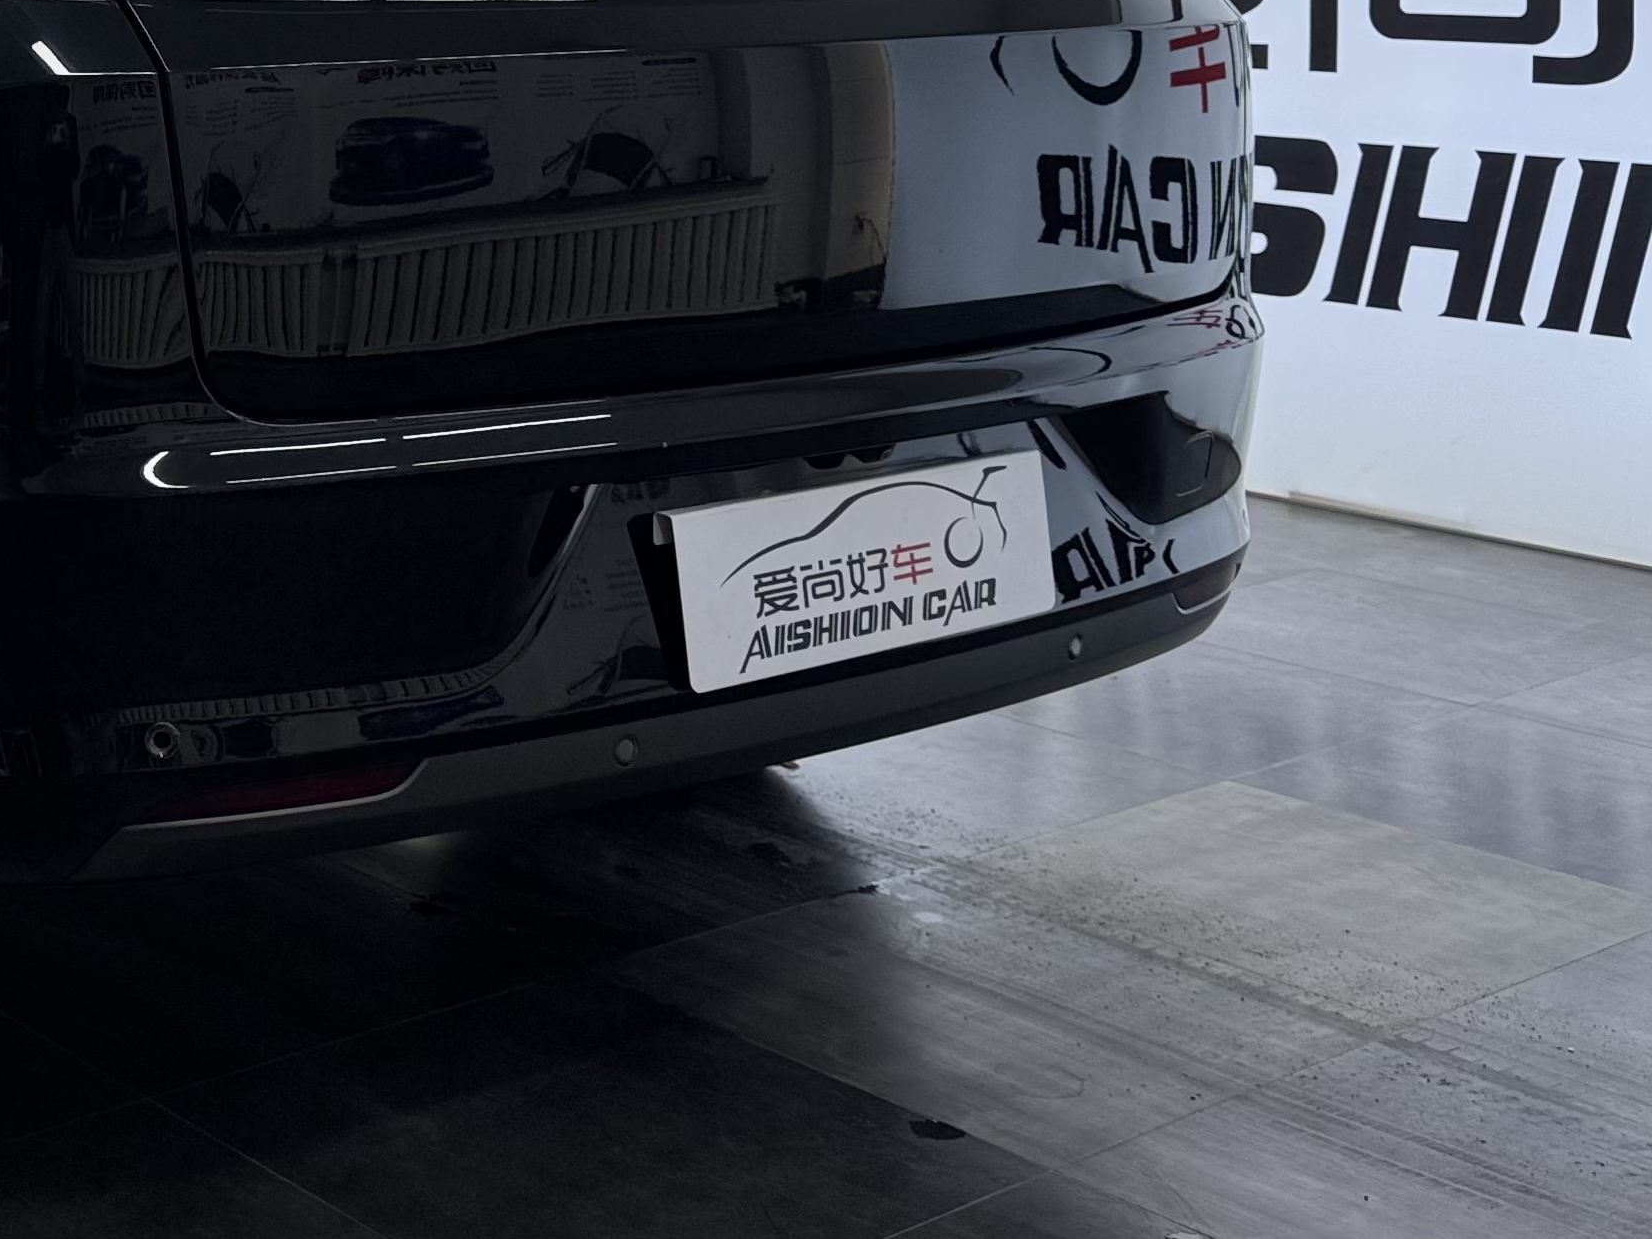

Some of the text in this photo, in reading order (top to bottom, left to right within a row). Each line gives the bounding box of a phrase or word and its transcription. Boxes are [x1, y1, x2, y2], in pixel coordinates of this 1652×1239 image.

[752, 542, 934, 619] 爱尚好车
[738, 577, 997, 675] AISHION CAR
